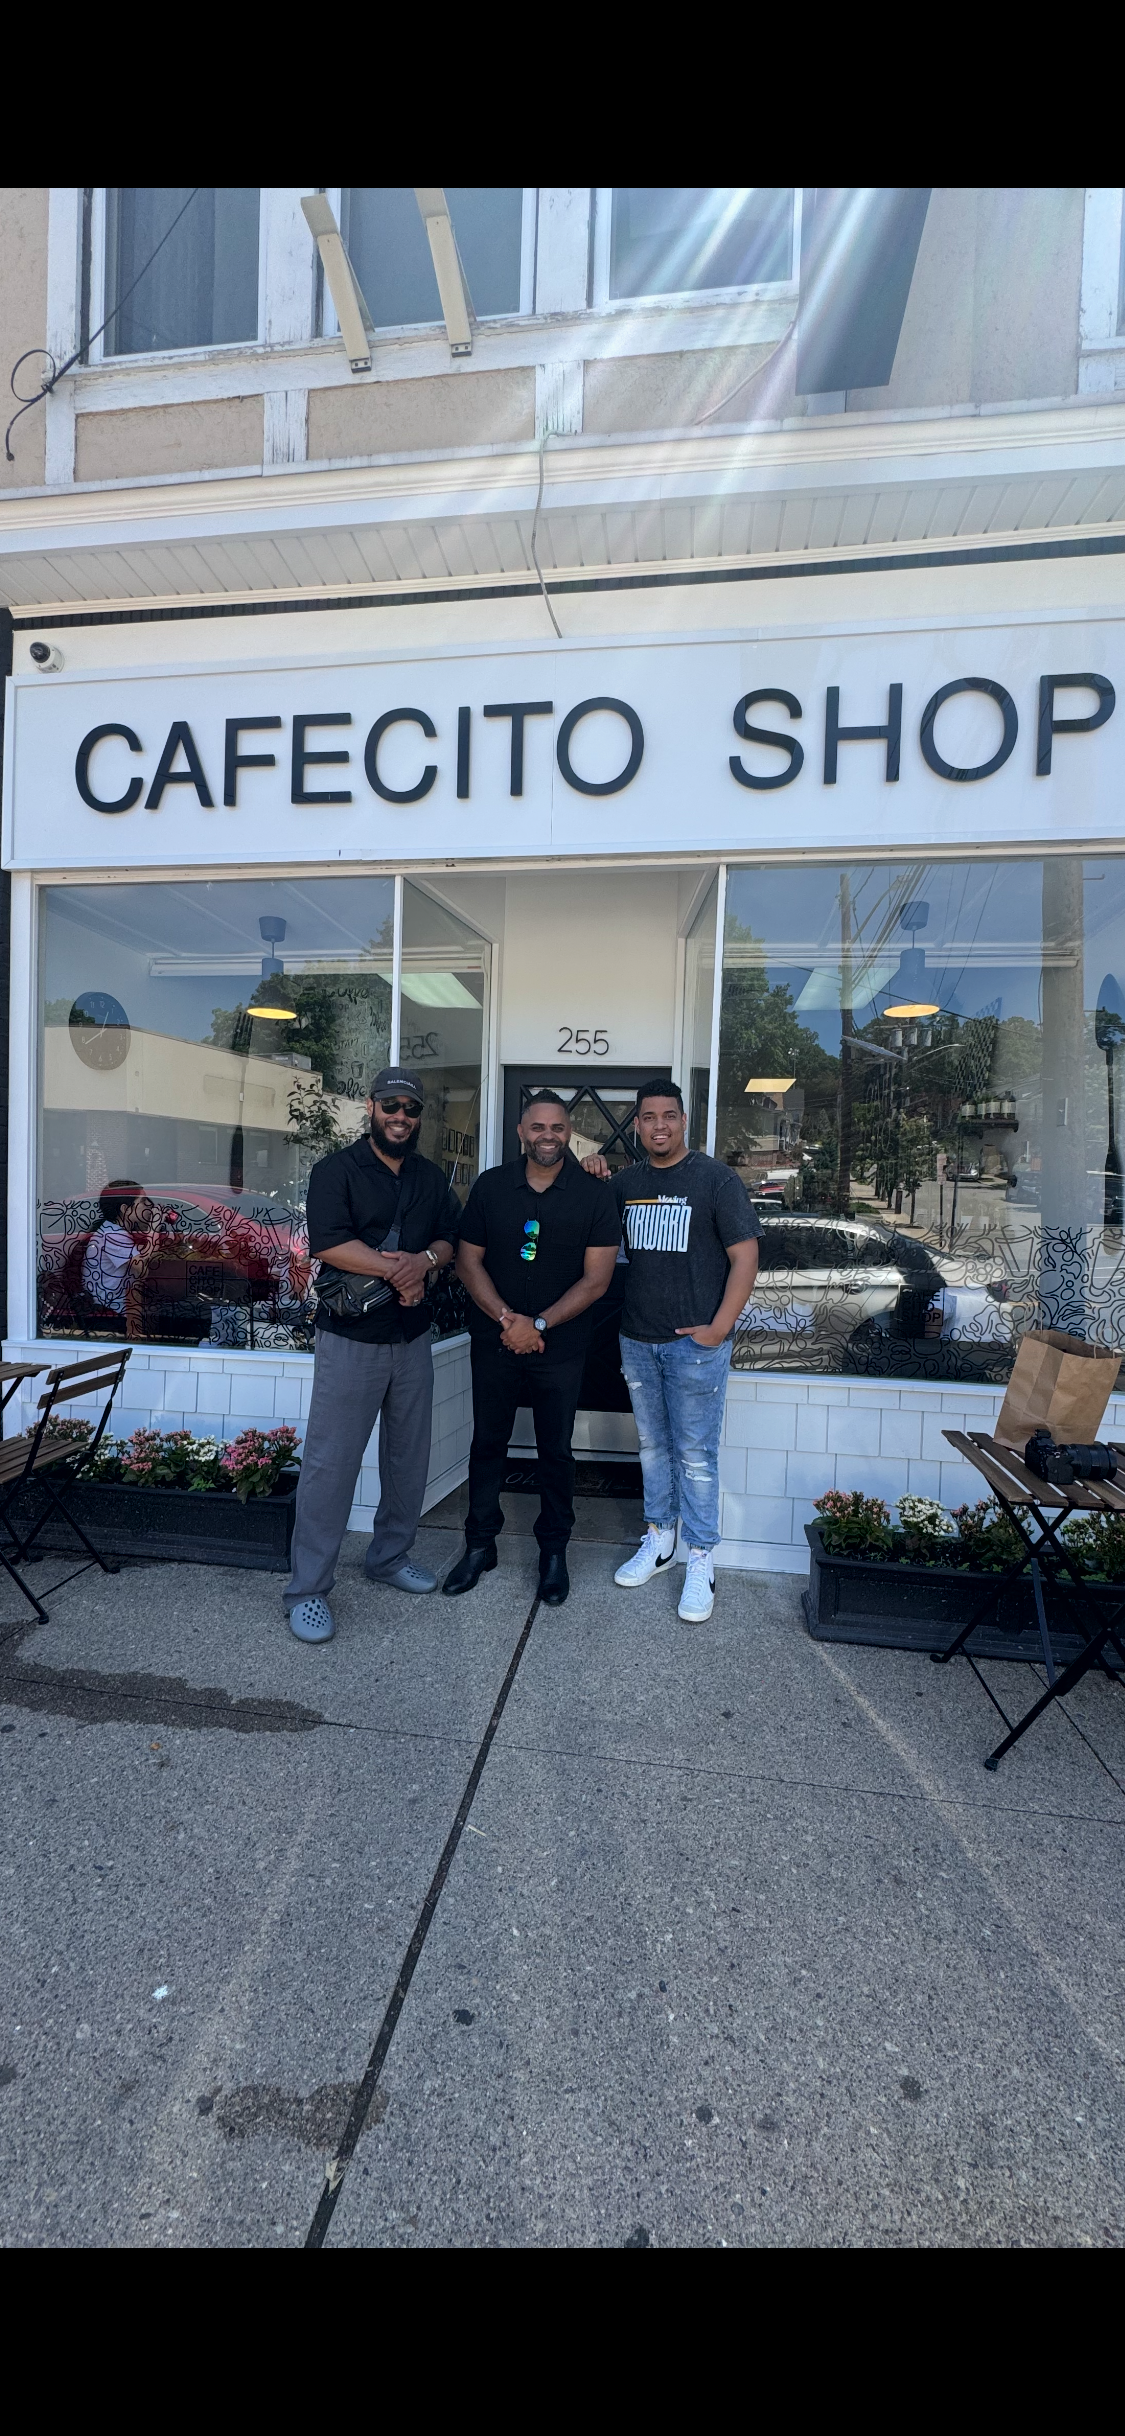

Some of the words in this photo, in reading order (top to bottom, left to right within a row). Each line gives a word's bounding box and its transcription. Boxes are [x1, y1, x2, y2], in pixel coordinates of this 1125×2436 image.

[74, 696, 645, 814] CAFECITO
[728, 671, 1116, 790] SHOP
[557, 1026, 610, 1056] 255
[189, 1265, 220, 1276] CAFE
[189, 1276, 215, 1286] CITO
[189, 1285, 221, 1295] SHOP
